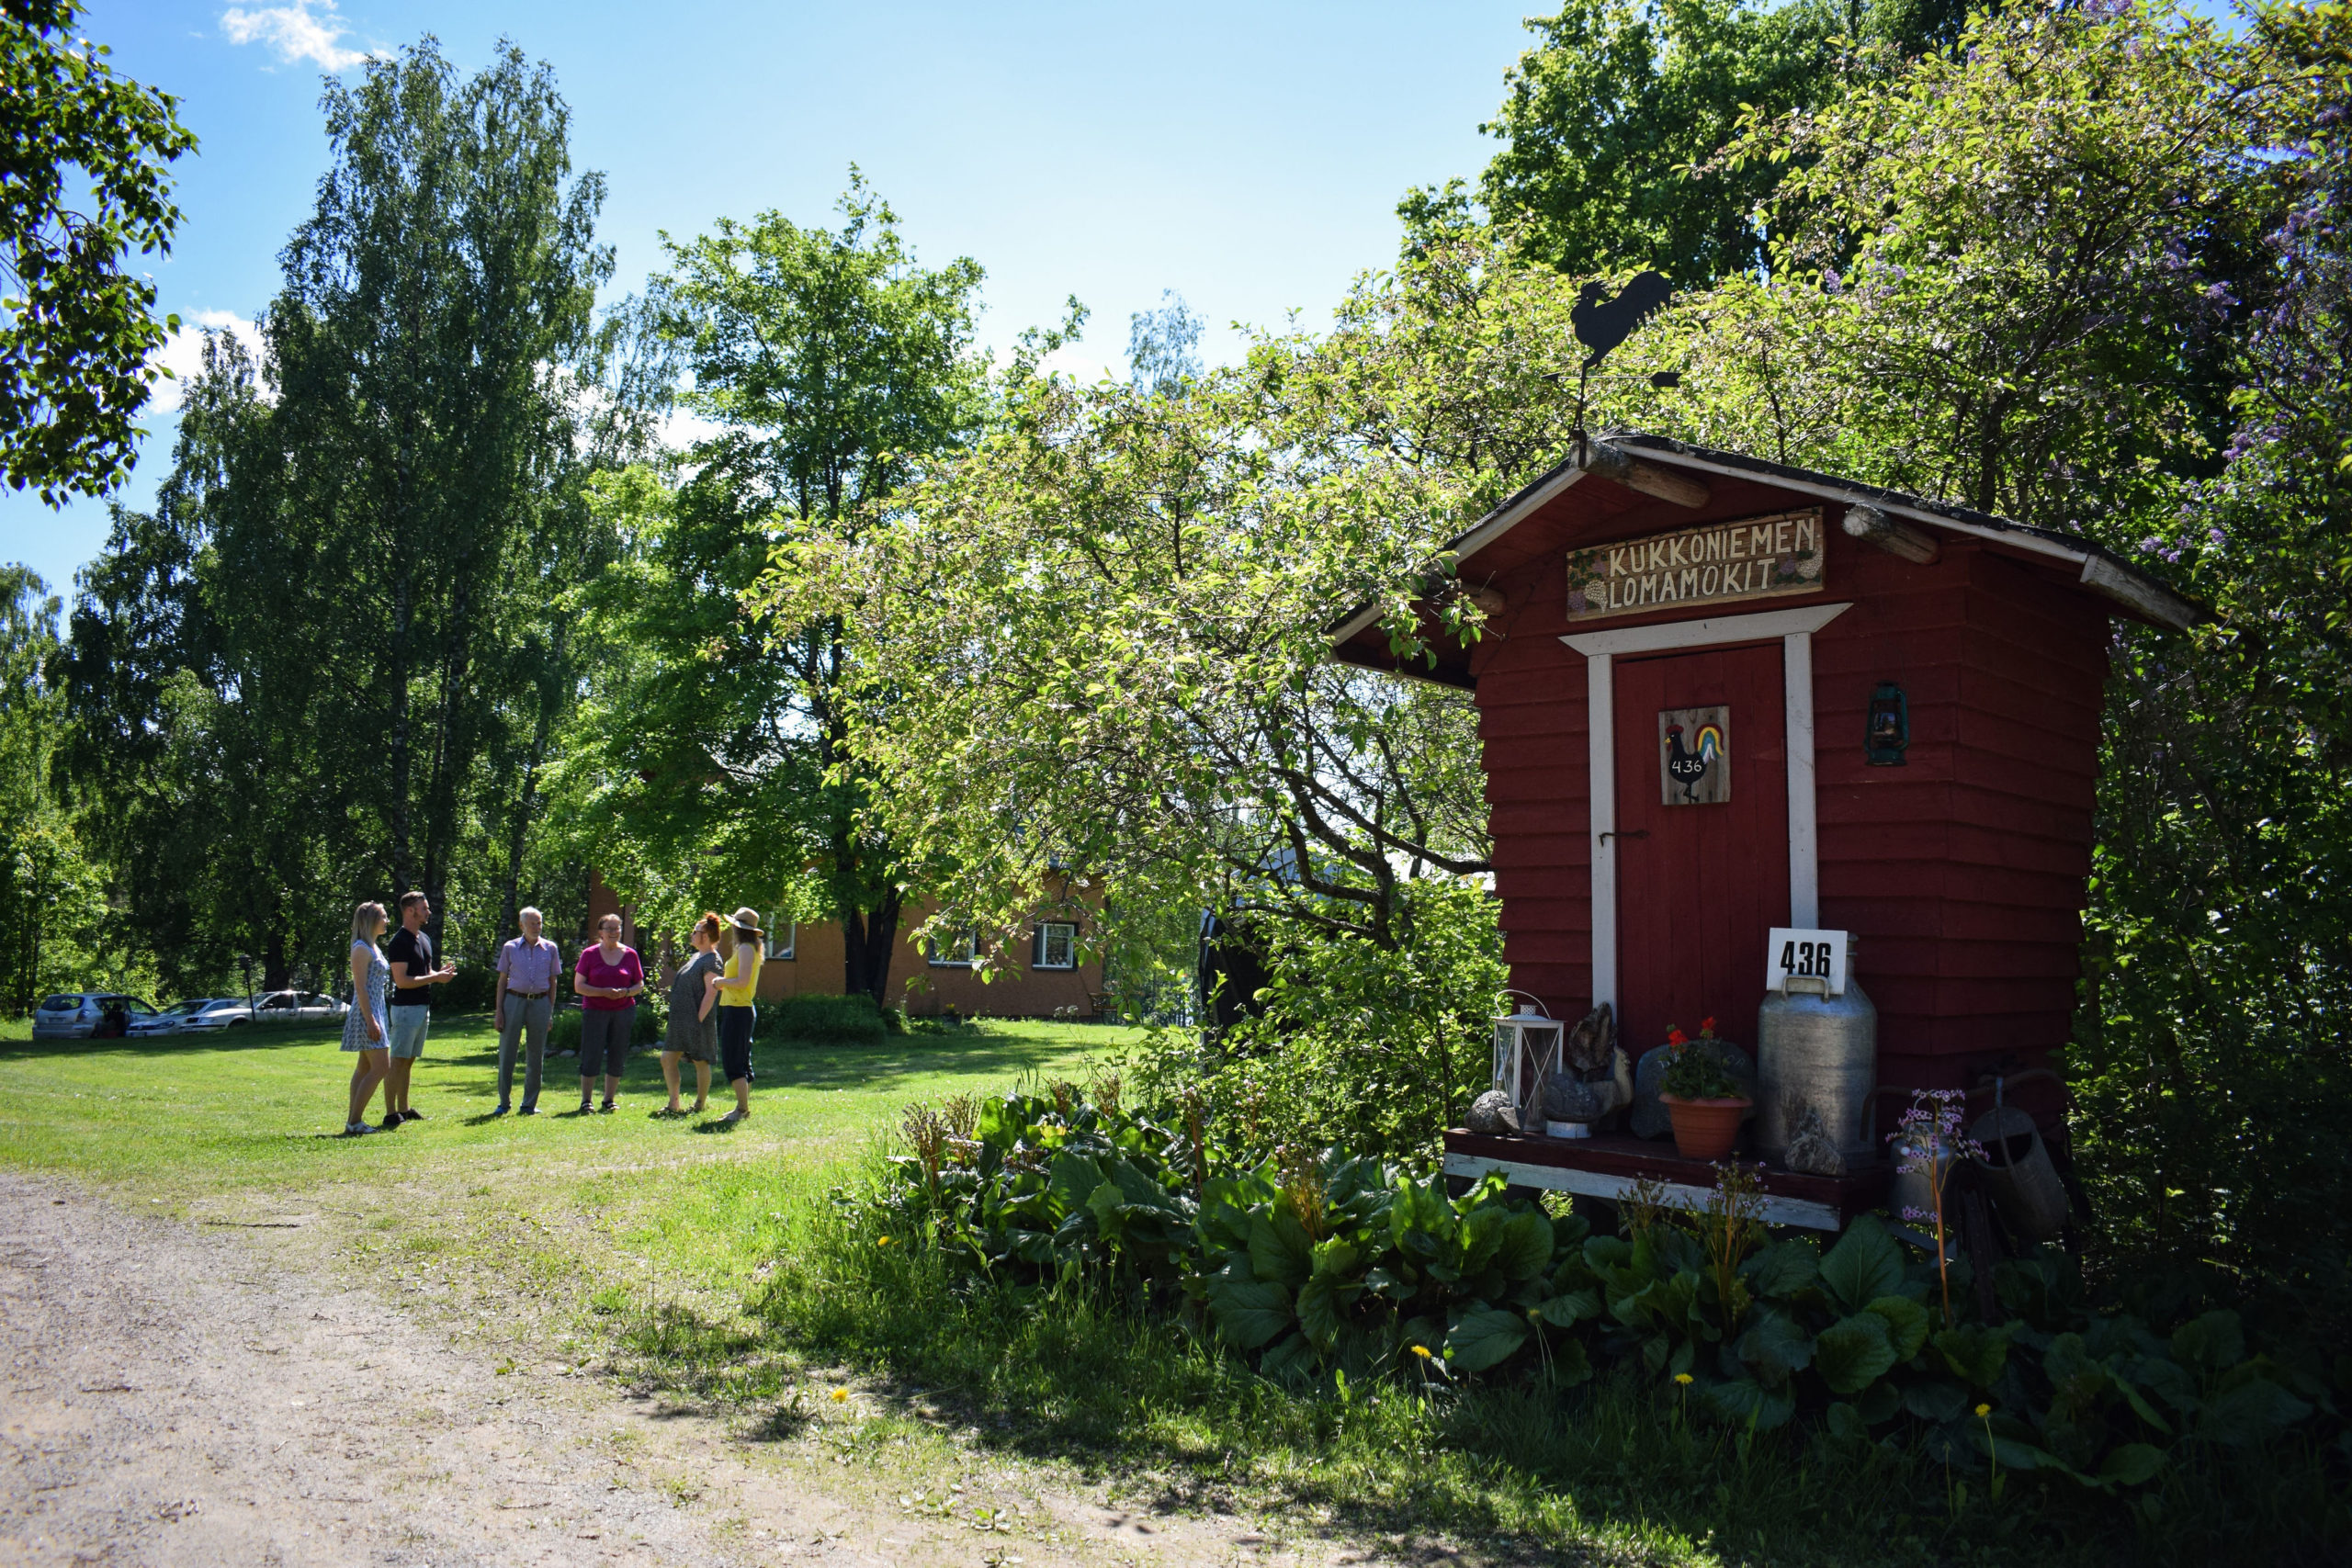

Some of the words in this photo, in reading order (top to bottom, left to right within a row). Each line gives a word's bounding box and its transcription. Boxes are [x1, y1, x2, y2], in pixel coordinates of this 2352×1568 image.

[1609, 517, 1815, 578] KUKKONIEMEN
[1609, 558, 1776, 609] LOMAMÖKIT
[1672, 760, 1702, 773] 436
[1781, 941, 1831, 977] 436
